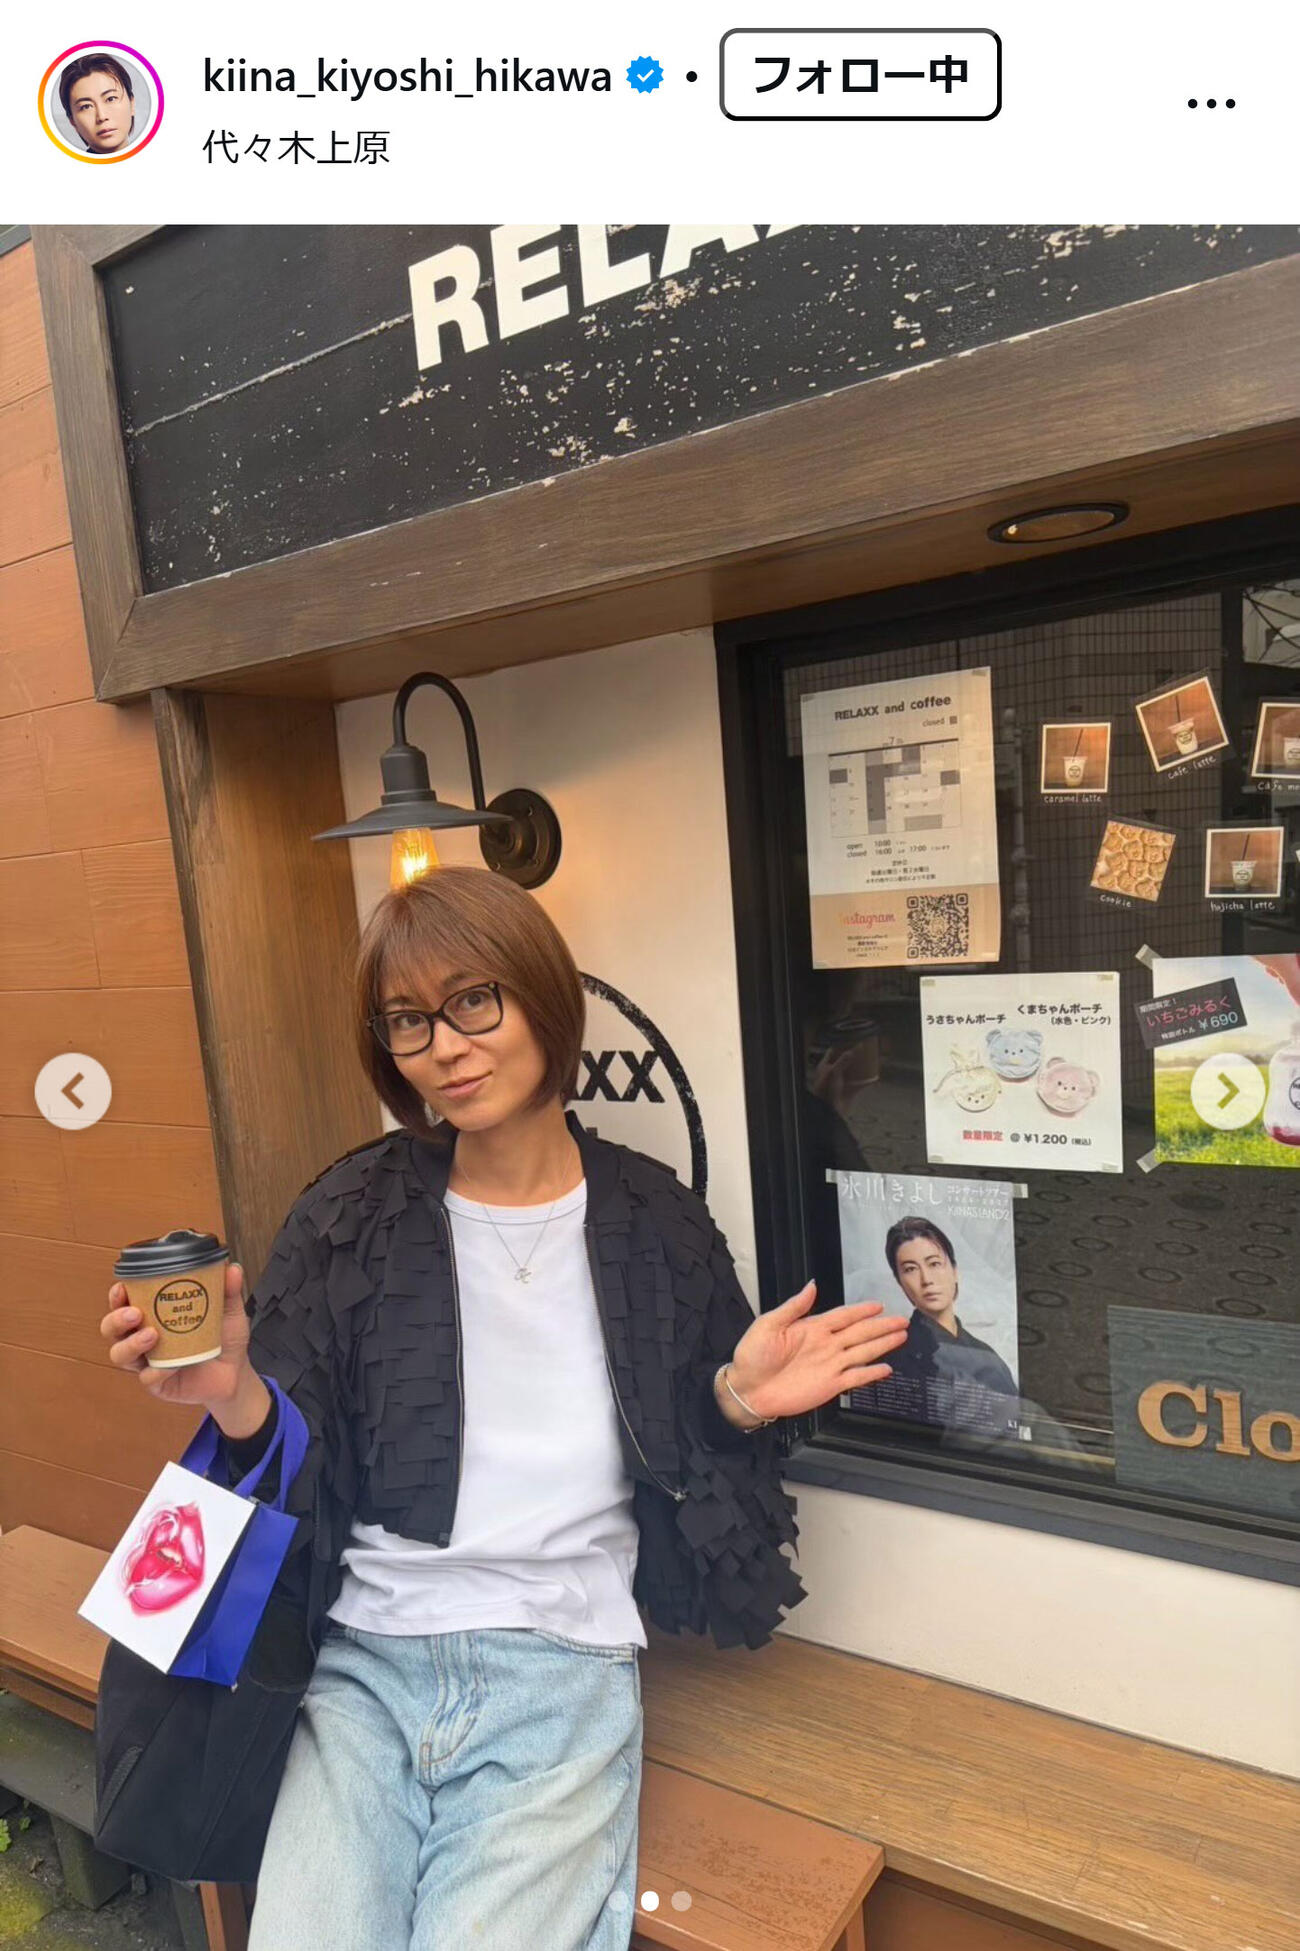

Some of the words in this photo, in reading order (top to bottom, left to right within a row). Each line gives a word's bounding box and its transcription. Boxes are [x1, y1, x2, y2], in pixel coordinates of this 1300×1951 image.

[408, 225, 801, 371] REL
[834, 705, 879, 721] RELAXX
[884, 701, 905, 714] and
[910, 696, 952, 711] coffee
[1017, 1003, 1102, 1015] くまちゃんポーチ
[926, 1013, 1007, 1025] うさちゃんポーチ
[1198, 1011, 1239, 1031] ¥690
[567, 1050, 666, 1103] XX
[962, 1129, 1003, 1142] 数量限定
[841, 1176, 943, 1205] 氷川きよし
[159, 1288, 205, 1303] RELAXX
[172, 1302, 193, 1314] and
[163, 1314, 202, 1327] coffee
[1137, 1379, 1300, 1463] Clo
